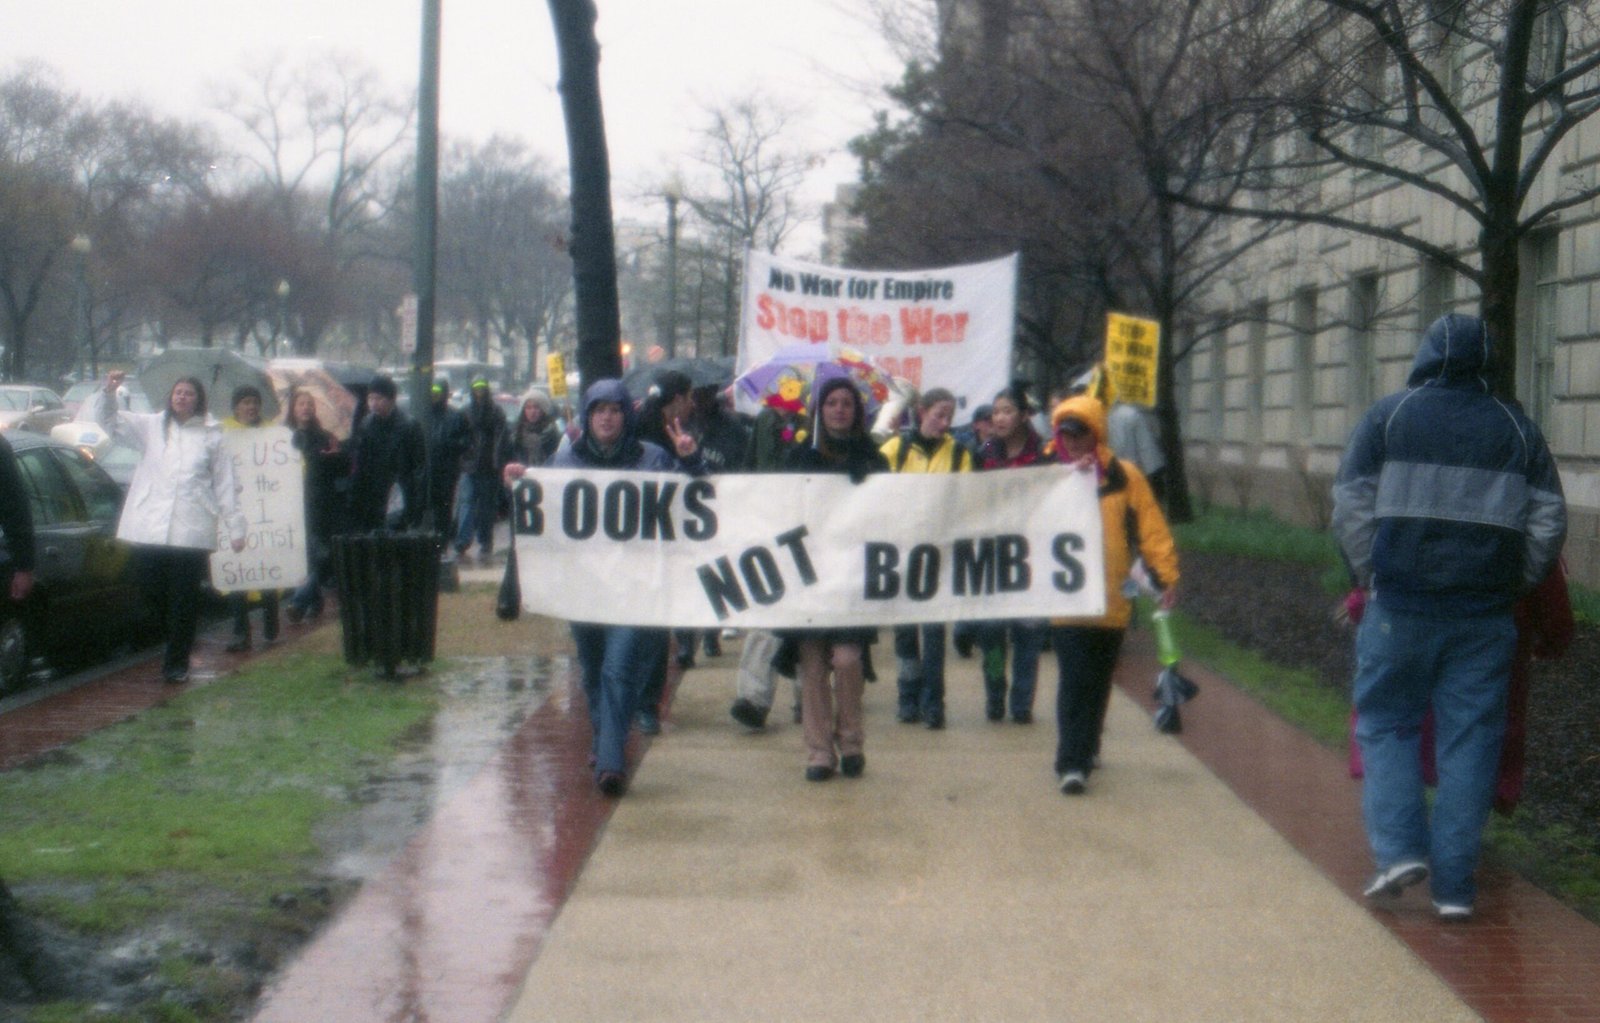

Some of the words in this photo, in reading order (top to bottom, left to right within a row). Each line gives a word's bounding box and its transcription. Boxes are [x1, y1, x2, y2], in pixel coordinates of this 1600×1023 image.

[769, 267, 795, 292] No
[800, 272, 842, 298] War
[848, 275, 877, 300] for
[884, 277, 954, 302] Empire
[757, 293, 829, 344] Stop
[837, 306, 892, 346] the
[900, 305, 969, 345] War
[255, 472, 281, 493] the
[514, 478, 718, 541] BOOKS
[222, 560, 283, 585] State
[696, 524, 818, 622] NOT
[863, 532, 1086, 602] BOMBS
